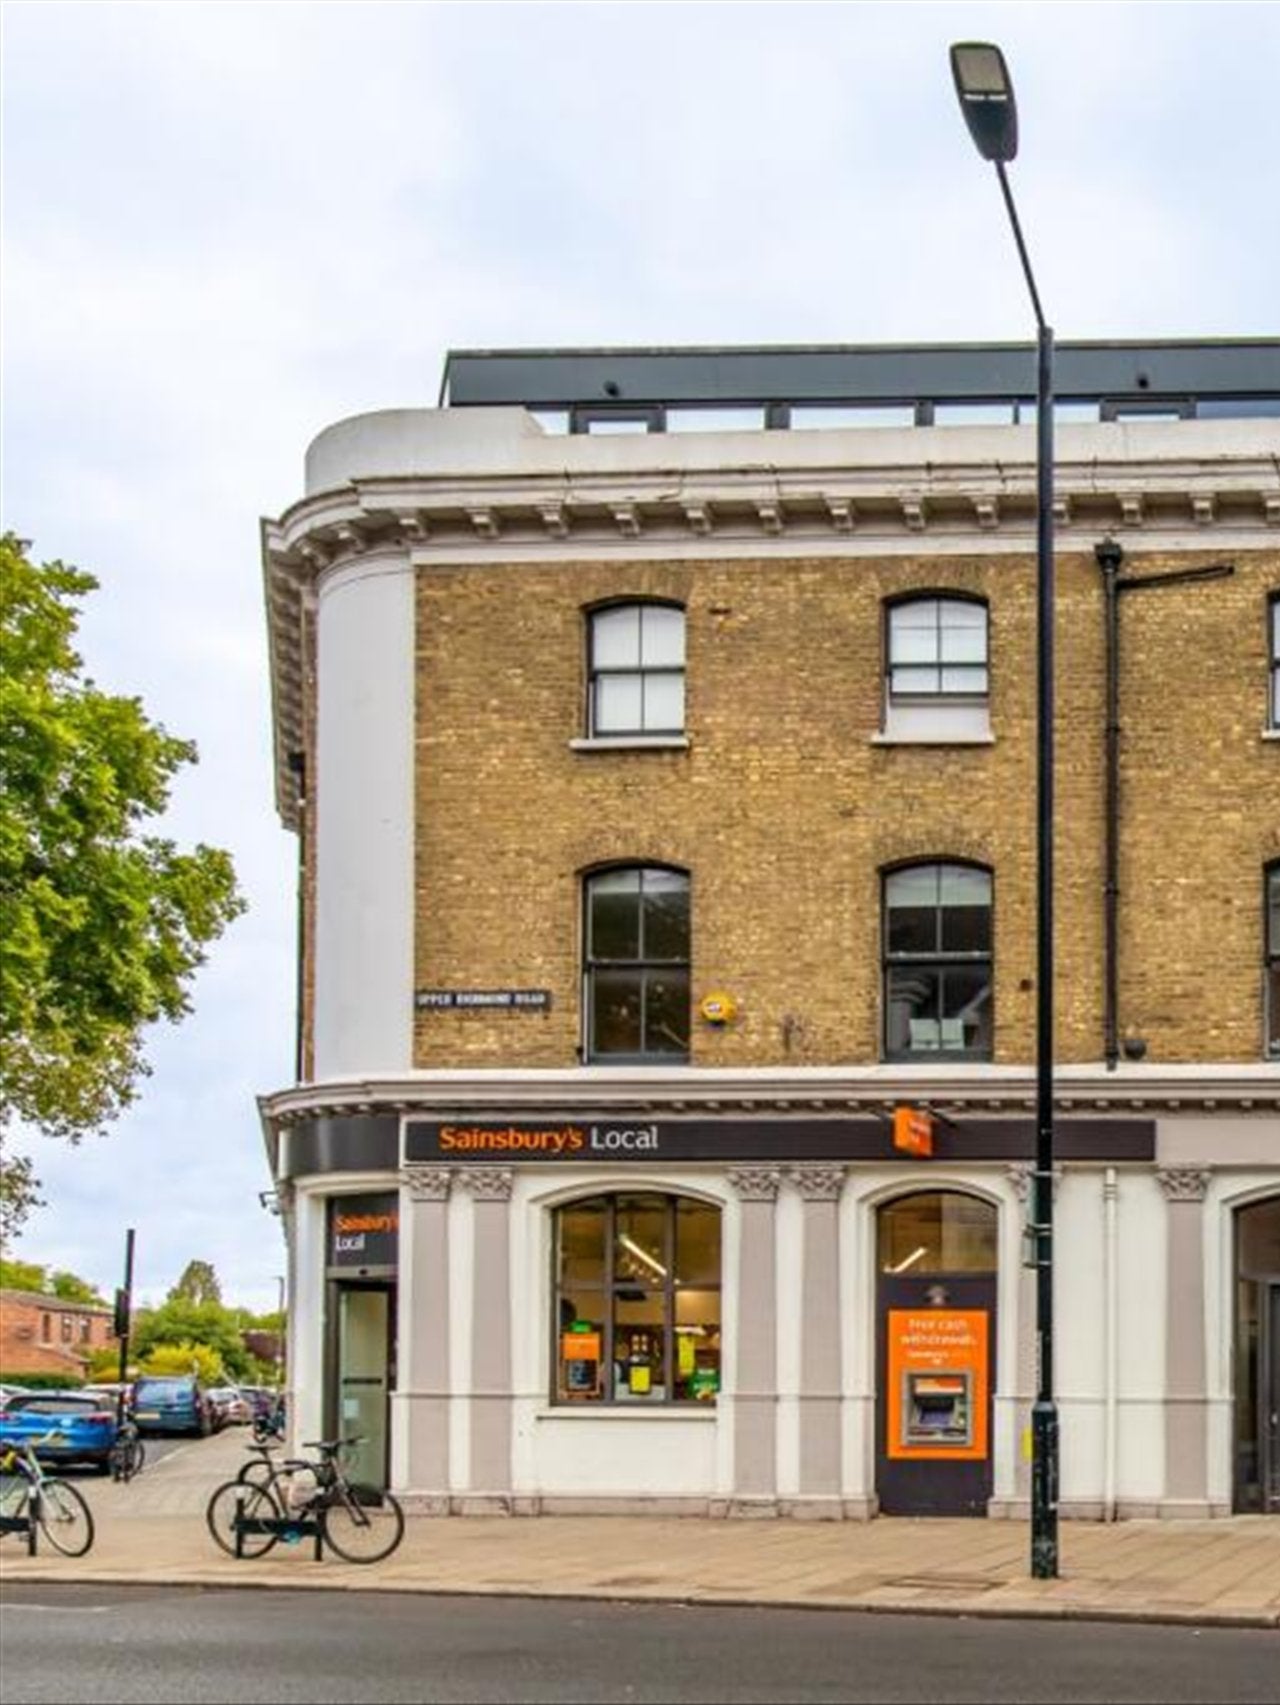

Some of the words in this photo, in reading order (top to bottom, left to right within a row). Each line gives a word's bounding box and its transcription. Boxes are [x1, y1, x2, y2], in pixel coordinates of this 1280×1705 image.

[438, 1126, 584, 1153] Sainsbury's
[590, 1125, 659, 1150] Local
[335, 1233, 365, 1251] Local
